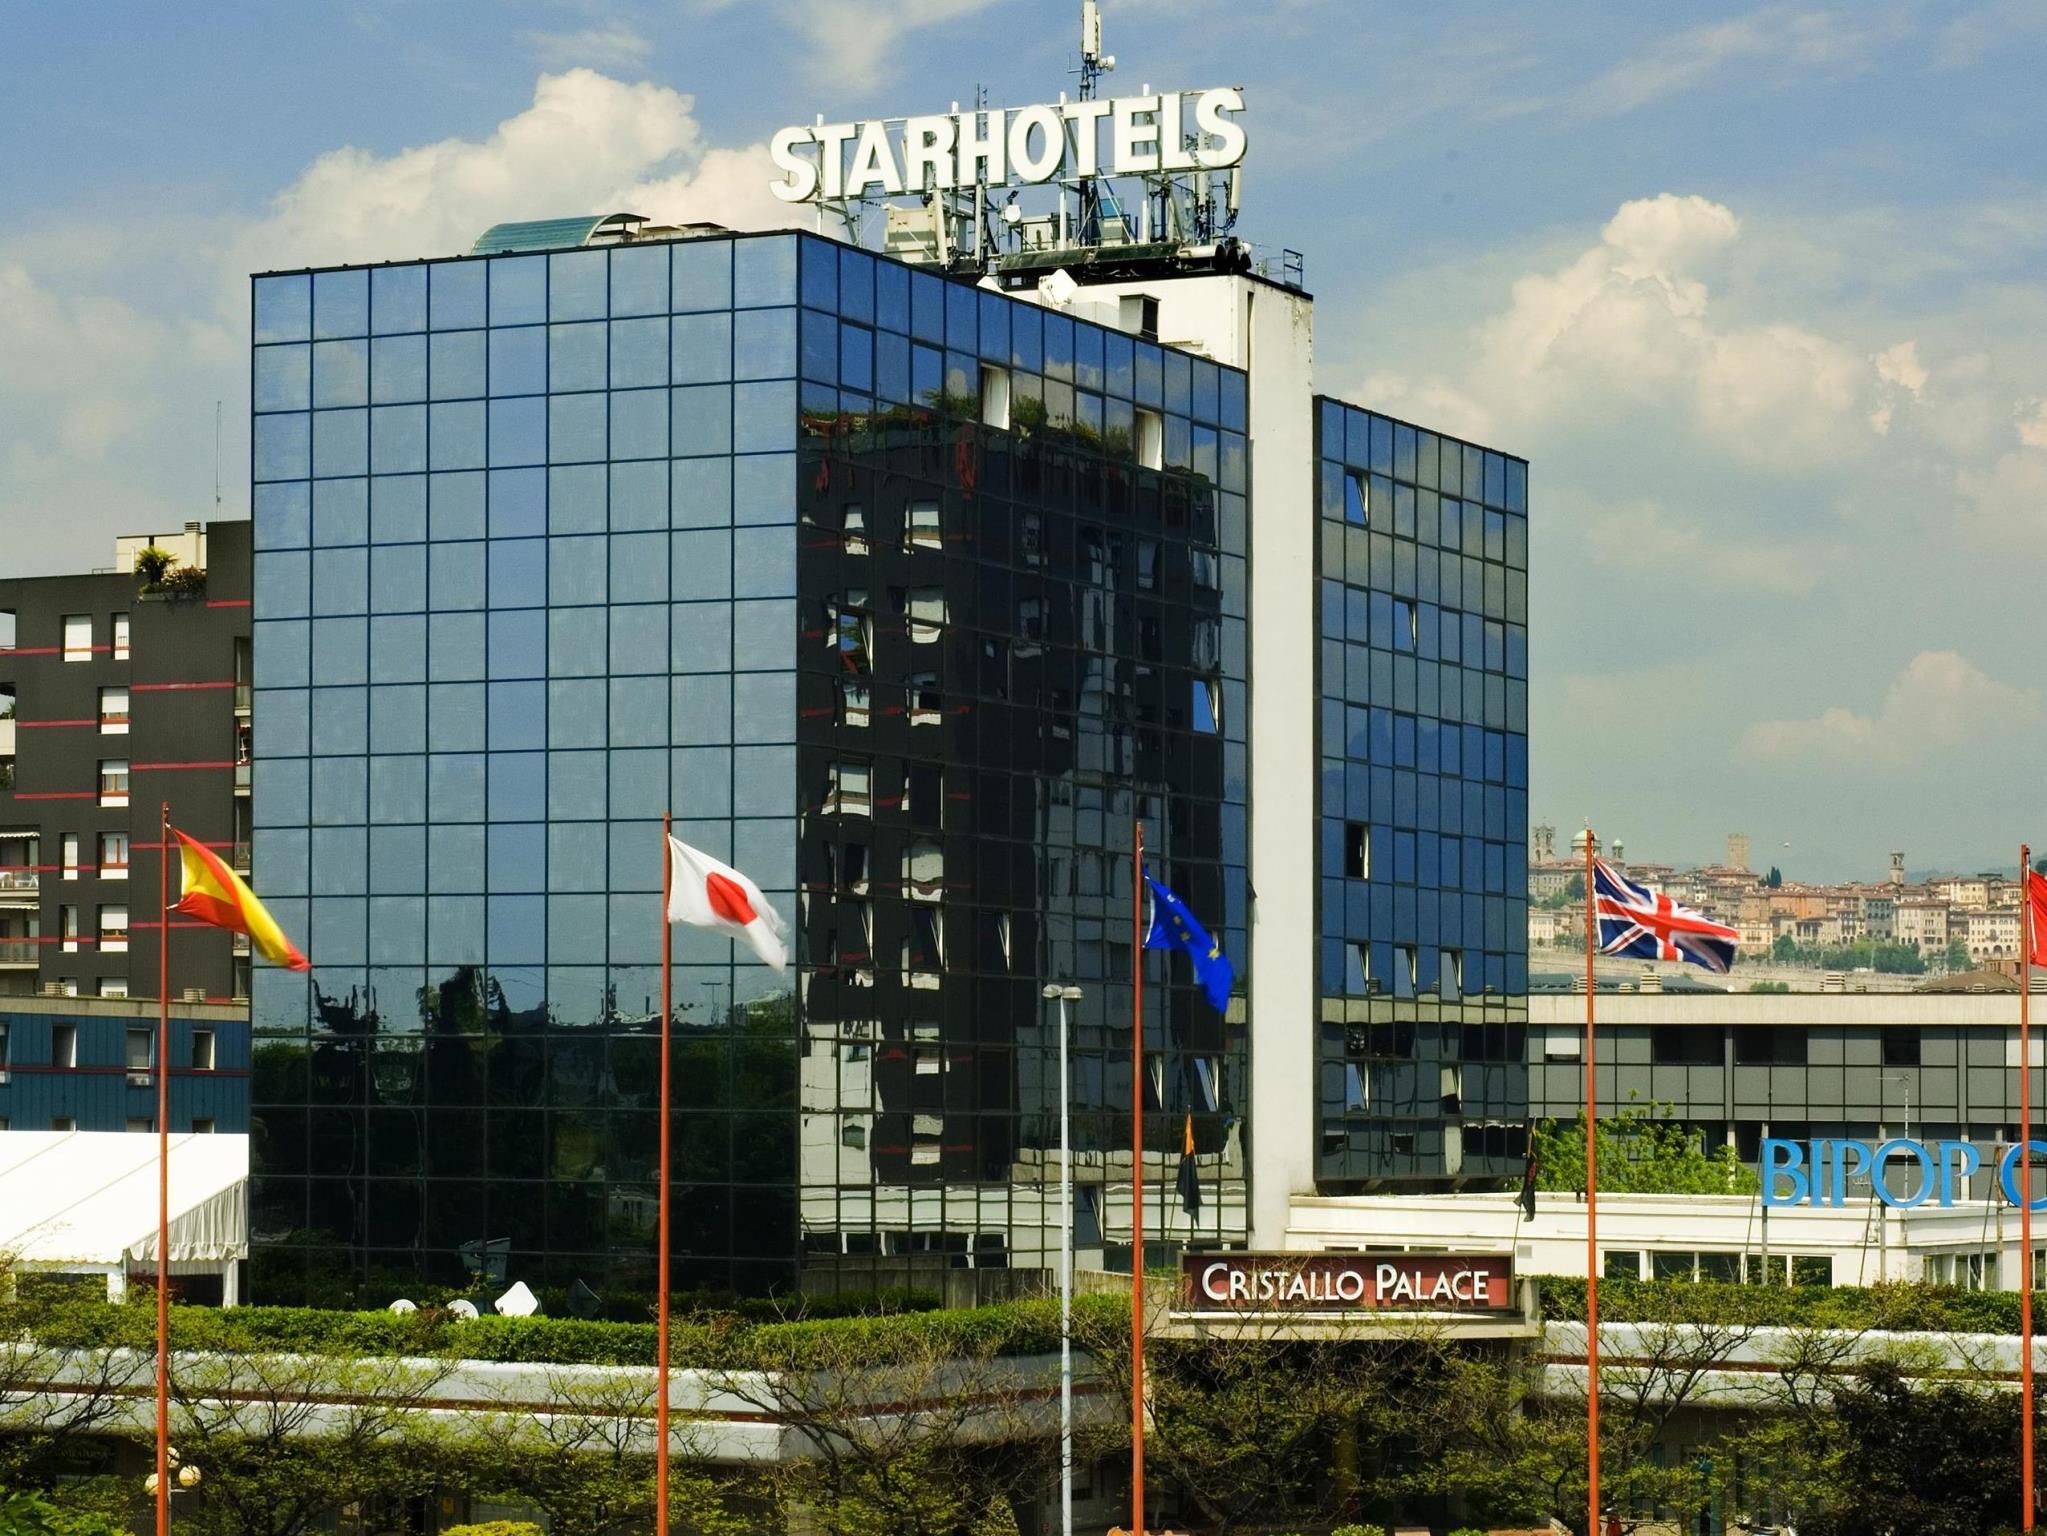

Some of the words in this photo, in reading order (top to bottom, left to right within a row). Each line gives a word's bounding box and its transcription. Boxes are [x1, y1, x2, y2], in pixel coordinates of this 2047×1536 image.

[769, 88, 1247, 202] STARHOTELS
[1760, 1138, 1981, 1208] BIPOP
[1201, 1262, 1364, 1301] CRISTALLO
[1376, 1263, 1490, 1300] PALACE
